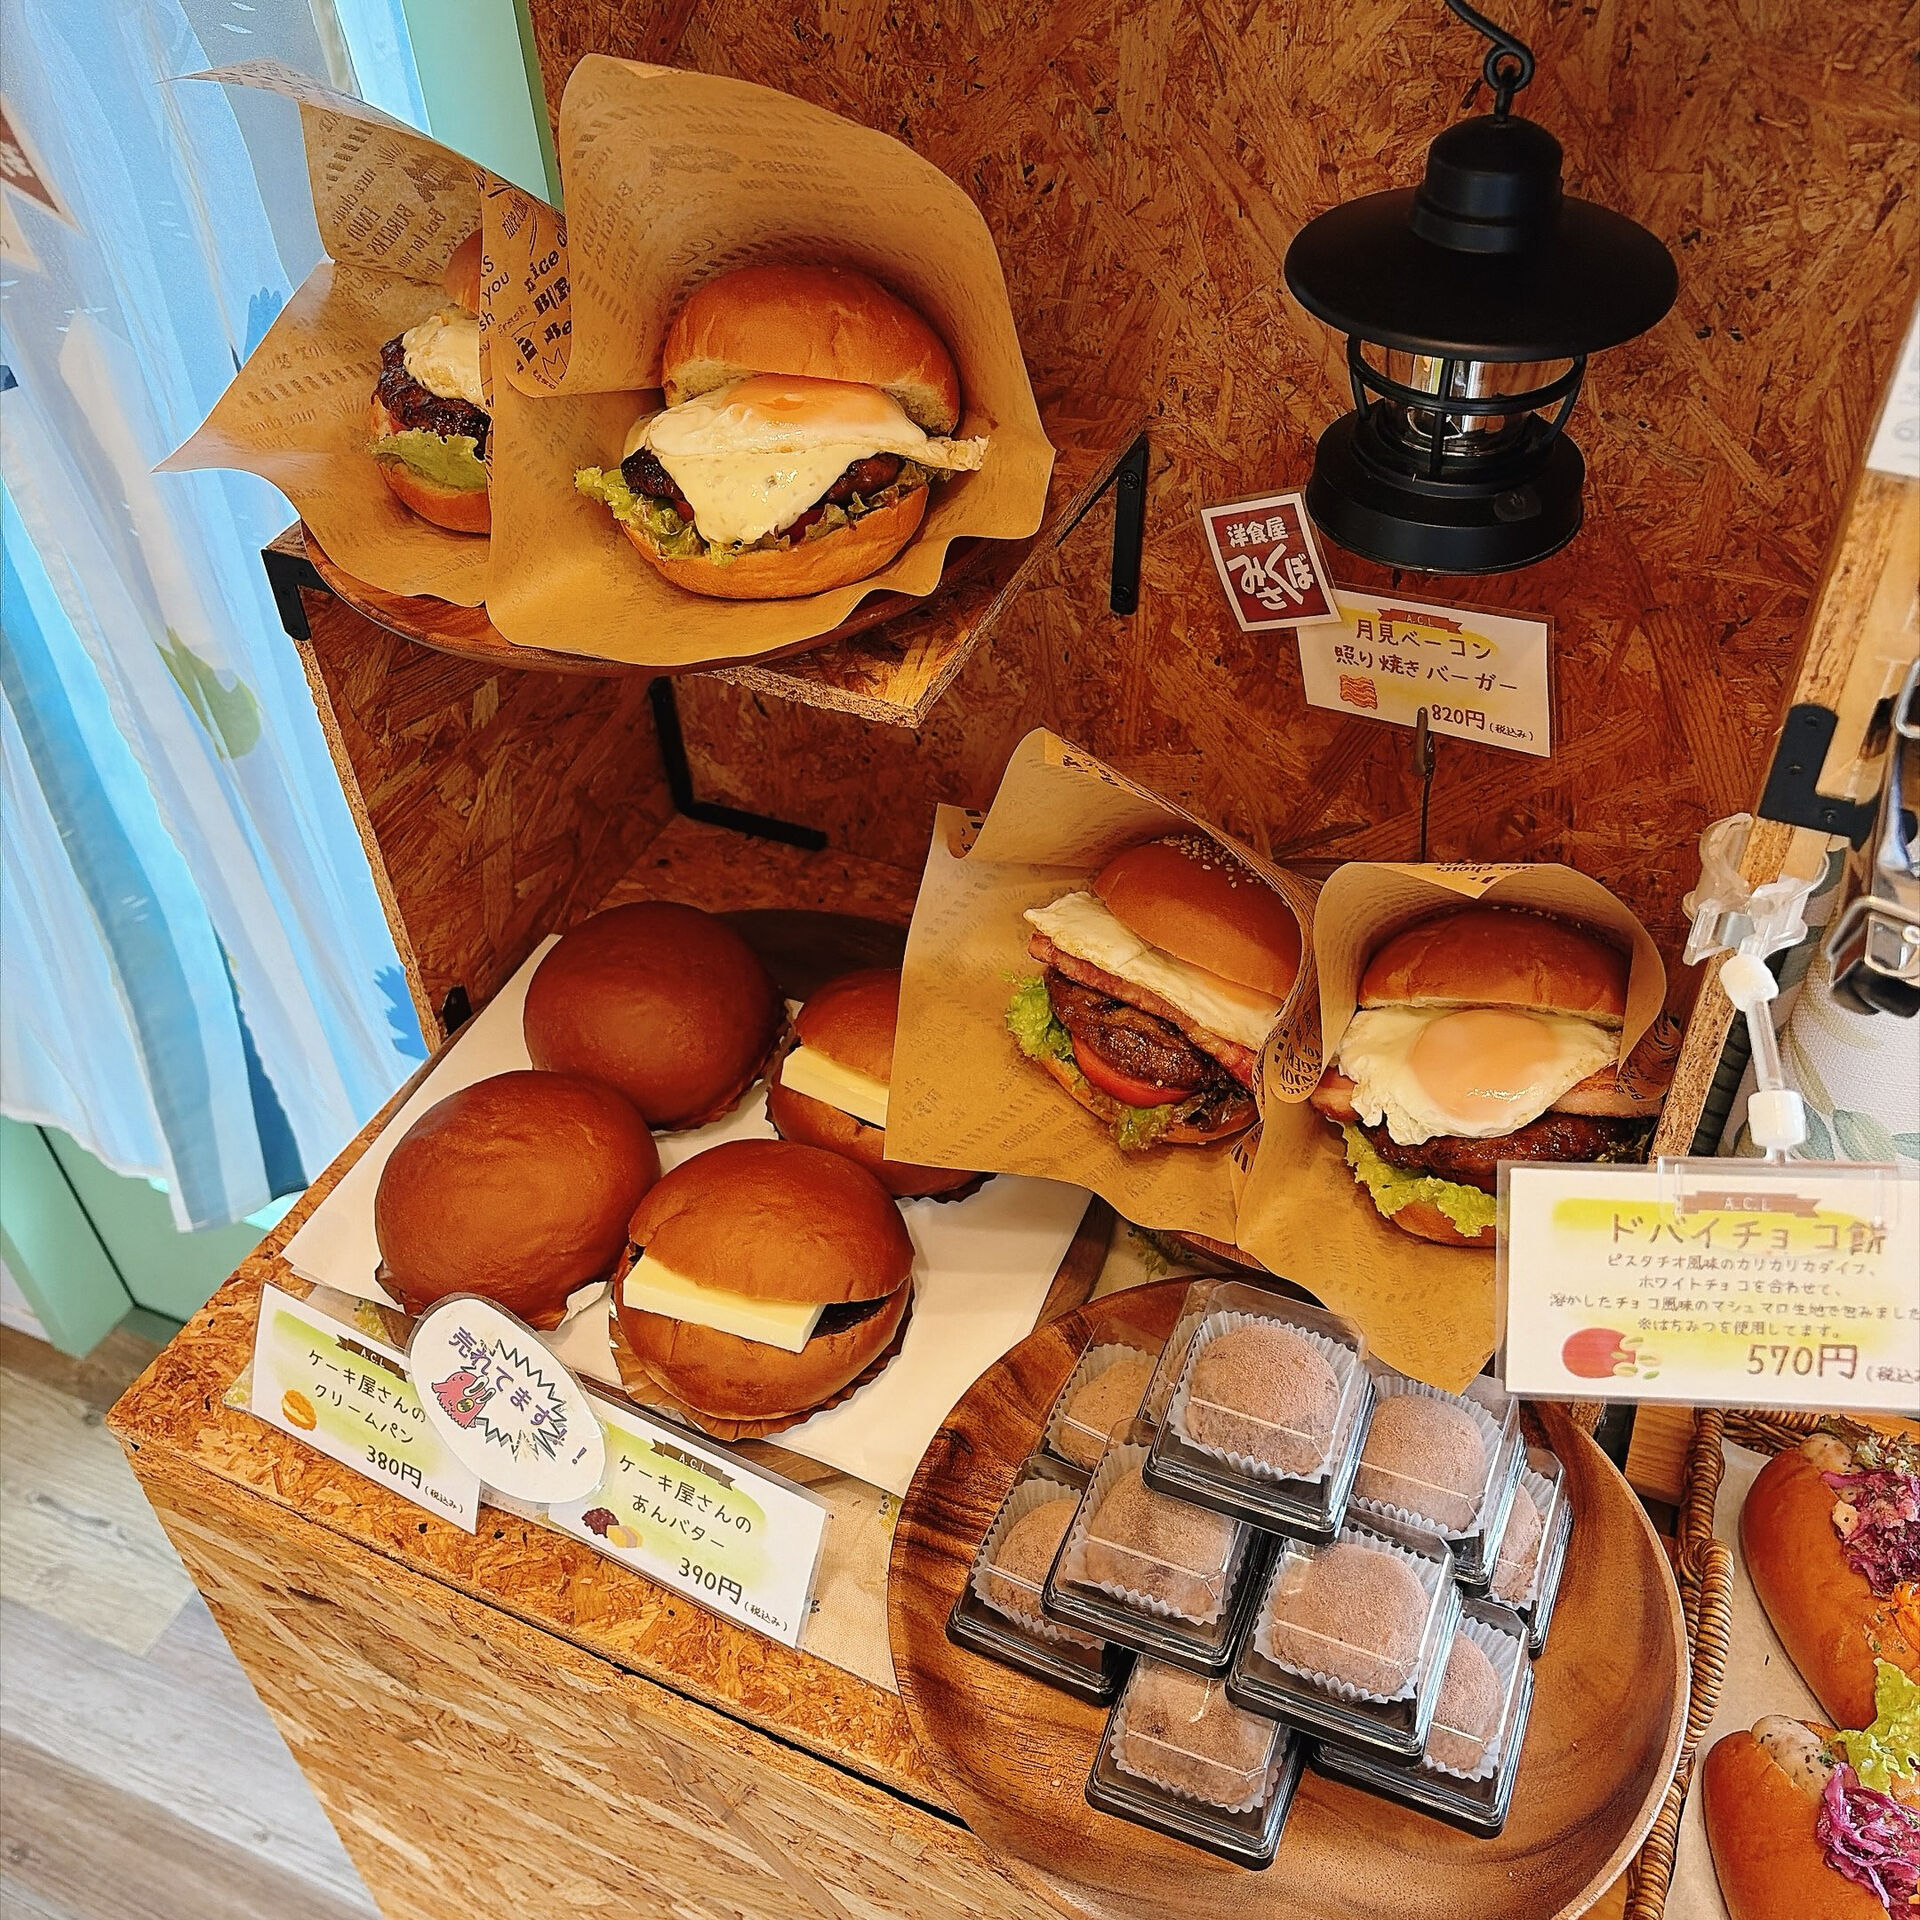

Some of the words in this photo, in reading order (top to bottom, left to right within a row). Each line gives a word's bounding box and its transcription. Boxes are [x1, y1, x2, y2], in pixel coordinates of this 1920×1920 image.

[482, 271, 510, 306] you
[1226, 516, 1289, 548] 洋食屋
[1356, 618, 1493, 660] 月見ベーコン
[1334, 645, 1519, 693] 照り焼きバーガー
[1431, 703, 1486, 731] 820円
[1611, 1212, 1889, 1256] ドバイチョコ餅
[1638, 1277, 1843, 1297] ホワイトチョコを合わせて、
[1747, 1343, 1859, 1380] 570円
[308, 1348, 426, 1424] ケーキ屋さんの
[314, 1384, 415, 1445] クリームパン
[366, 1444, 423, 1490] 380円
[619, 1454, 752, 1535] ケーキ屋さんの
[631, 1493, 726, 1550] あんバター
[678, 1557, 743, 1606] 390円
